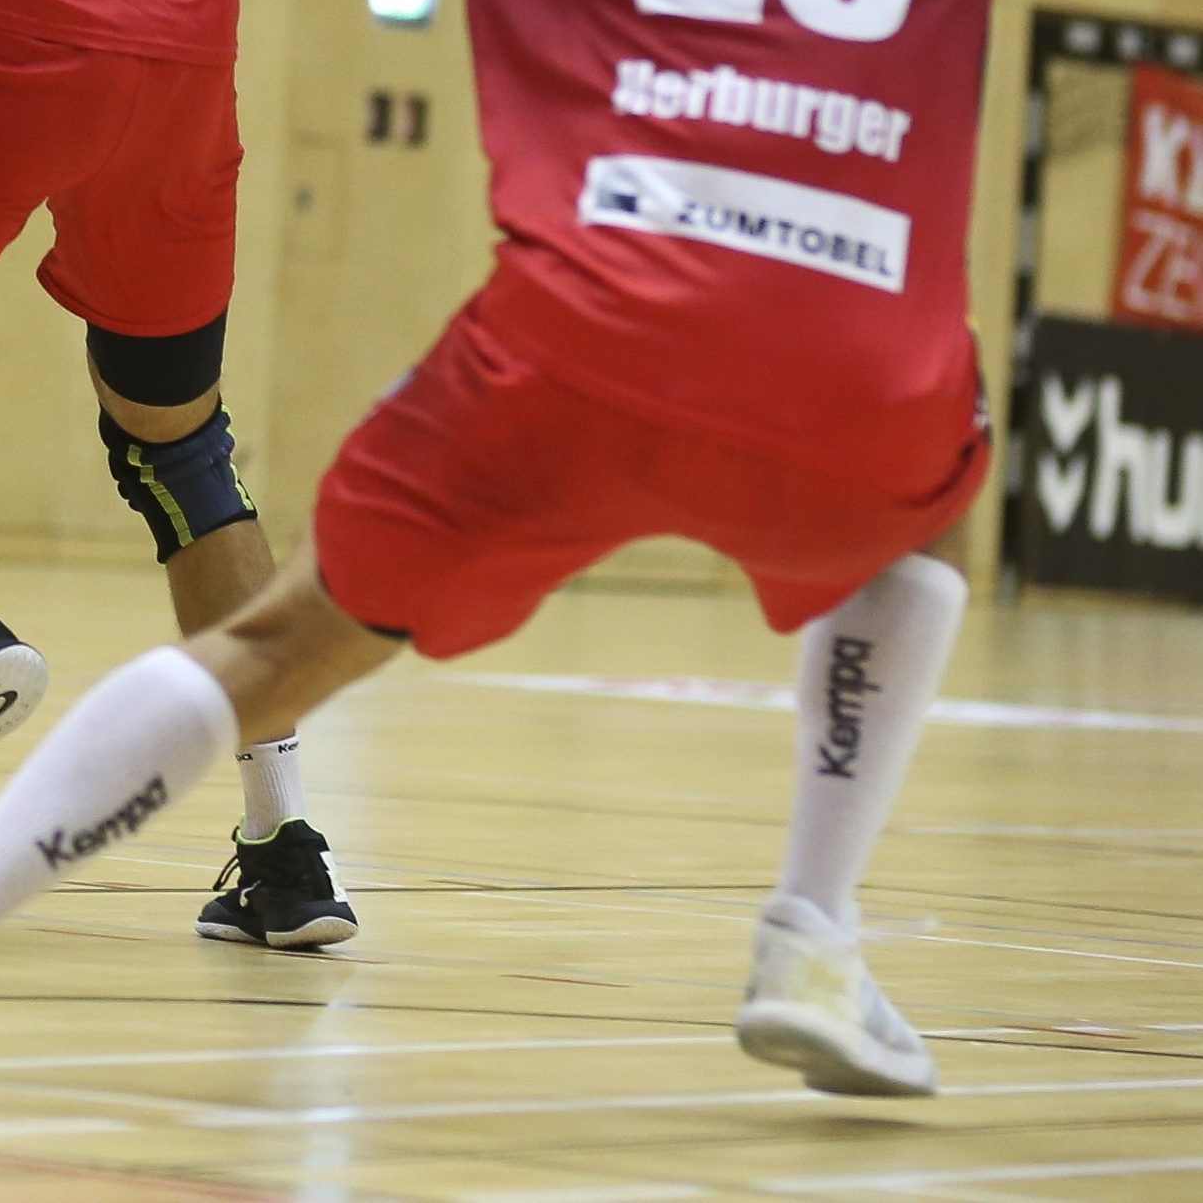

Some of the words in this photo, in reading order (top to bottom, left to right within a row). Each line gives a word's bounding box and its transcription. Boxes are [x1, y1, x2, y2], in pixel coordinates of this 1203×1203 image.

[677, 201, 893, 277] ZUMTOBEL
[816, 636, 882, 779] Kempa
[35, 774, 168, 871] Kempa
